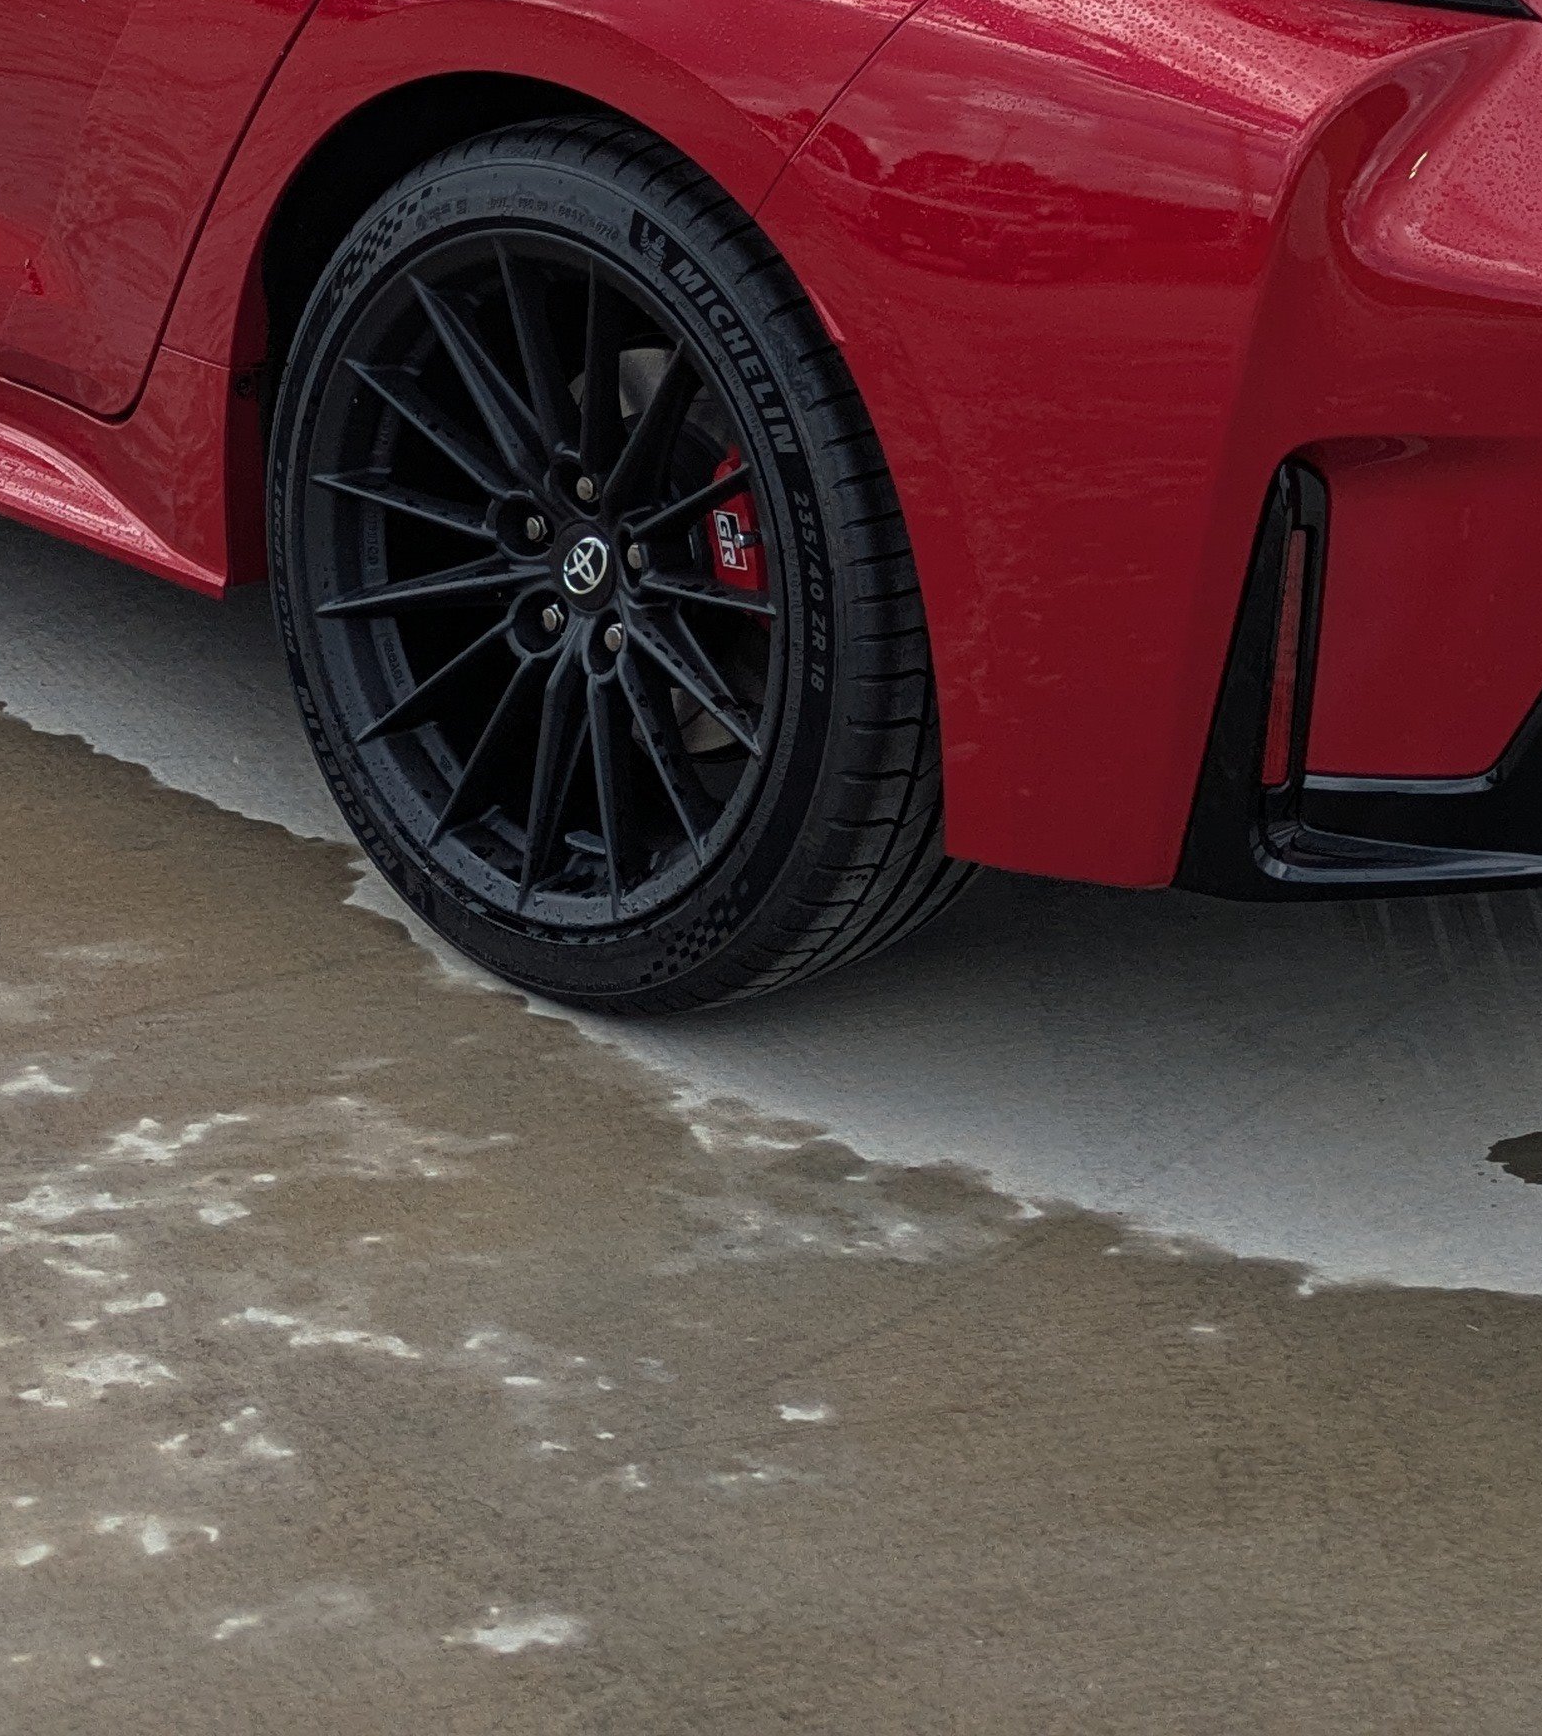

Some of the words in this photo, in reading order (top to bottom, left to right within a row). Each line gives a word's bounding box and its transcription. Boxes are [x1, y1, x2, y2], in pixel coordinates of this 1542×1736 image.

[669, 259, 799, 453] MICHELIN
[716, 513, 737, 565] GR
[792, 490, 825, 602] 235/40
[811, 610, 827, 652] ZR
[810, 665, 826, 693] 18
[297, 685, 399, 871] MICHELIN
